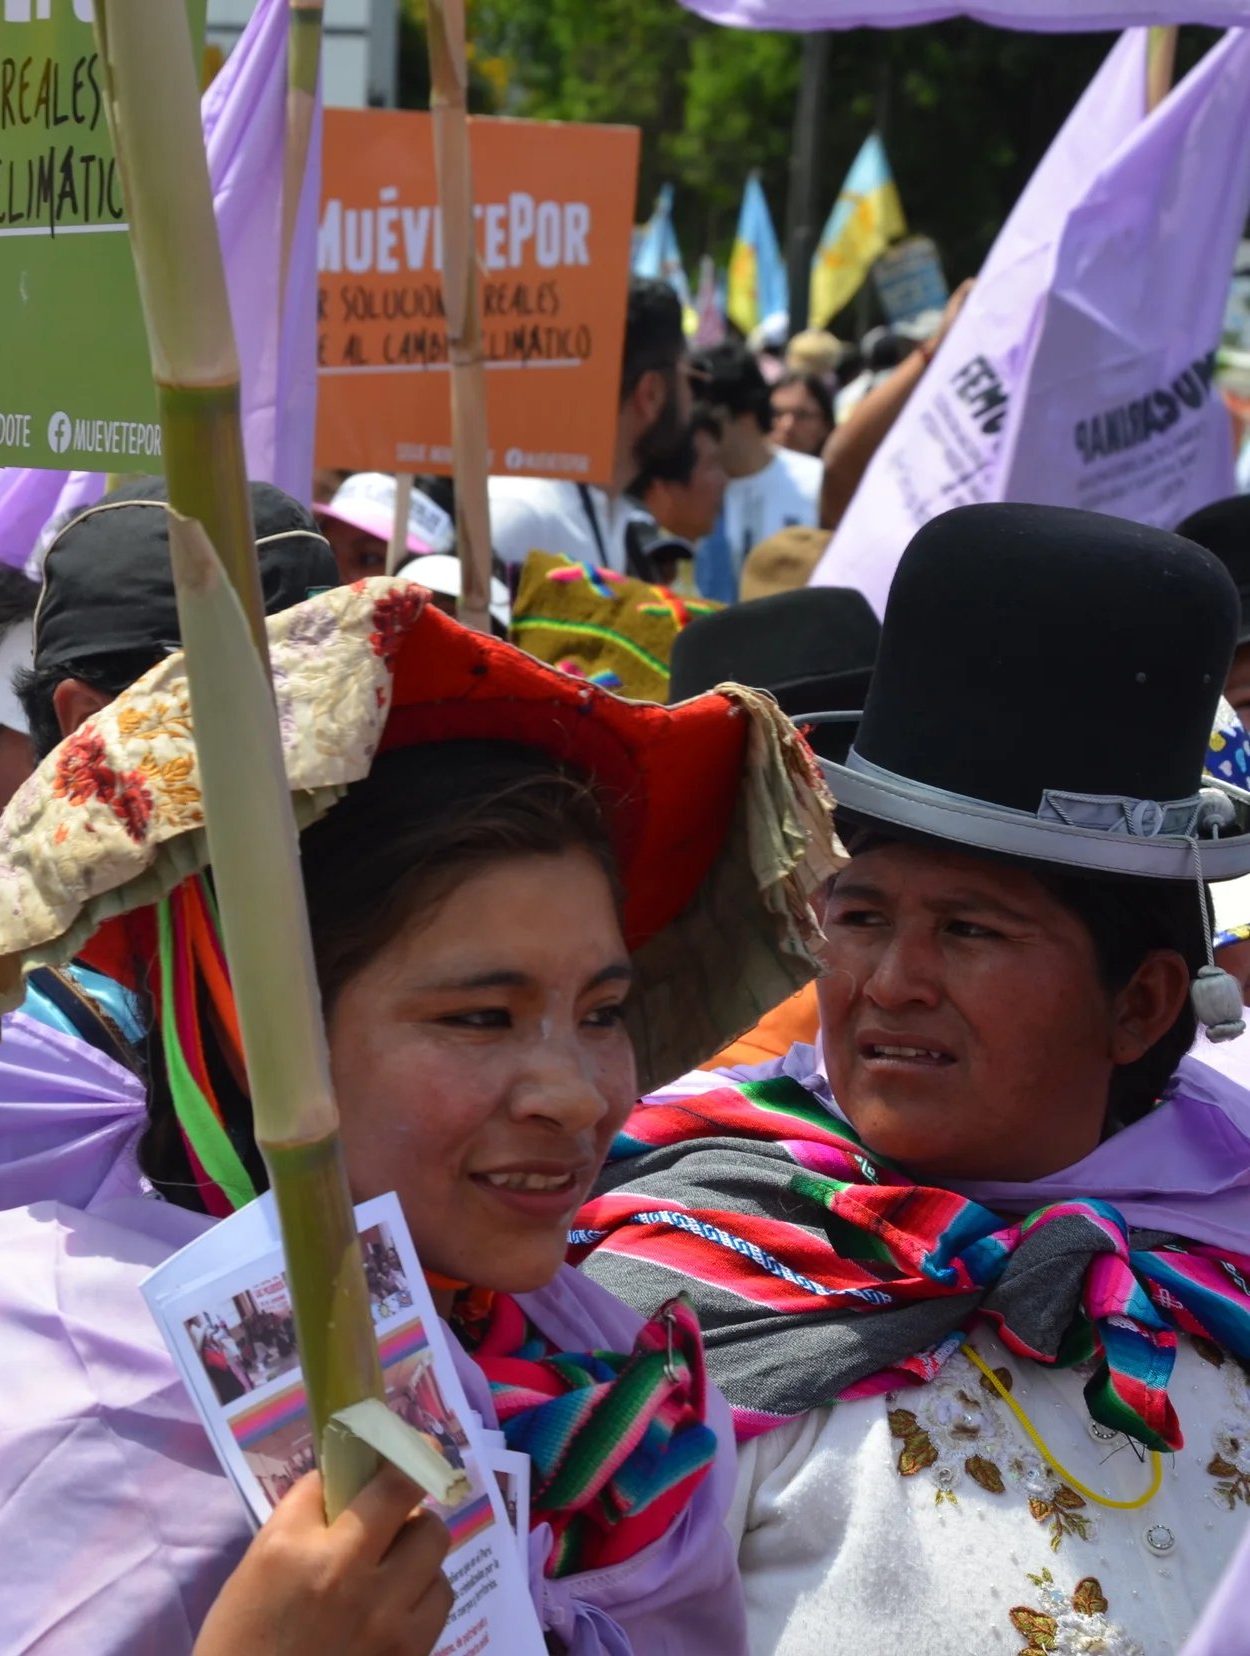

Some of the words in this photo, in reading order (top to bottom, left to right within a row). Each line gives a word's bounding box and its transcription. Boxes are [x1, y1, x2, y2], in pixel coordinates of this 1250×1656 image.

[1, 53, 101, 131] REALES
[483, 280, 561, 318] REALES
[342, 331, 370, 367] AL
[72, 418, 162, 456] MUEVETEPOR
